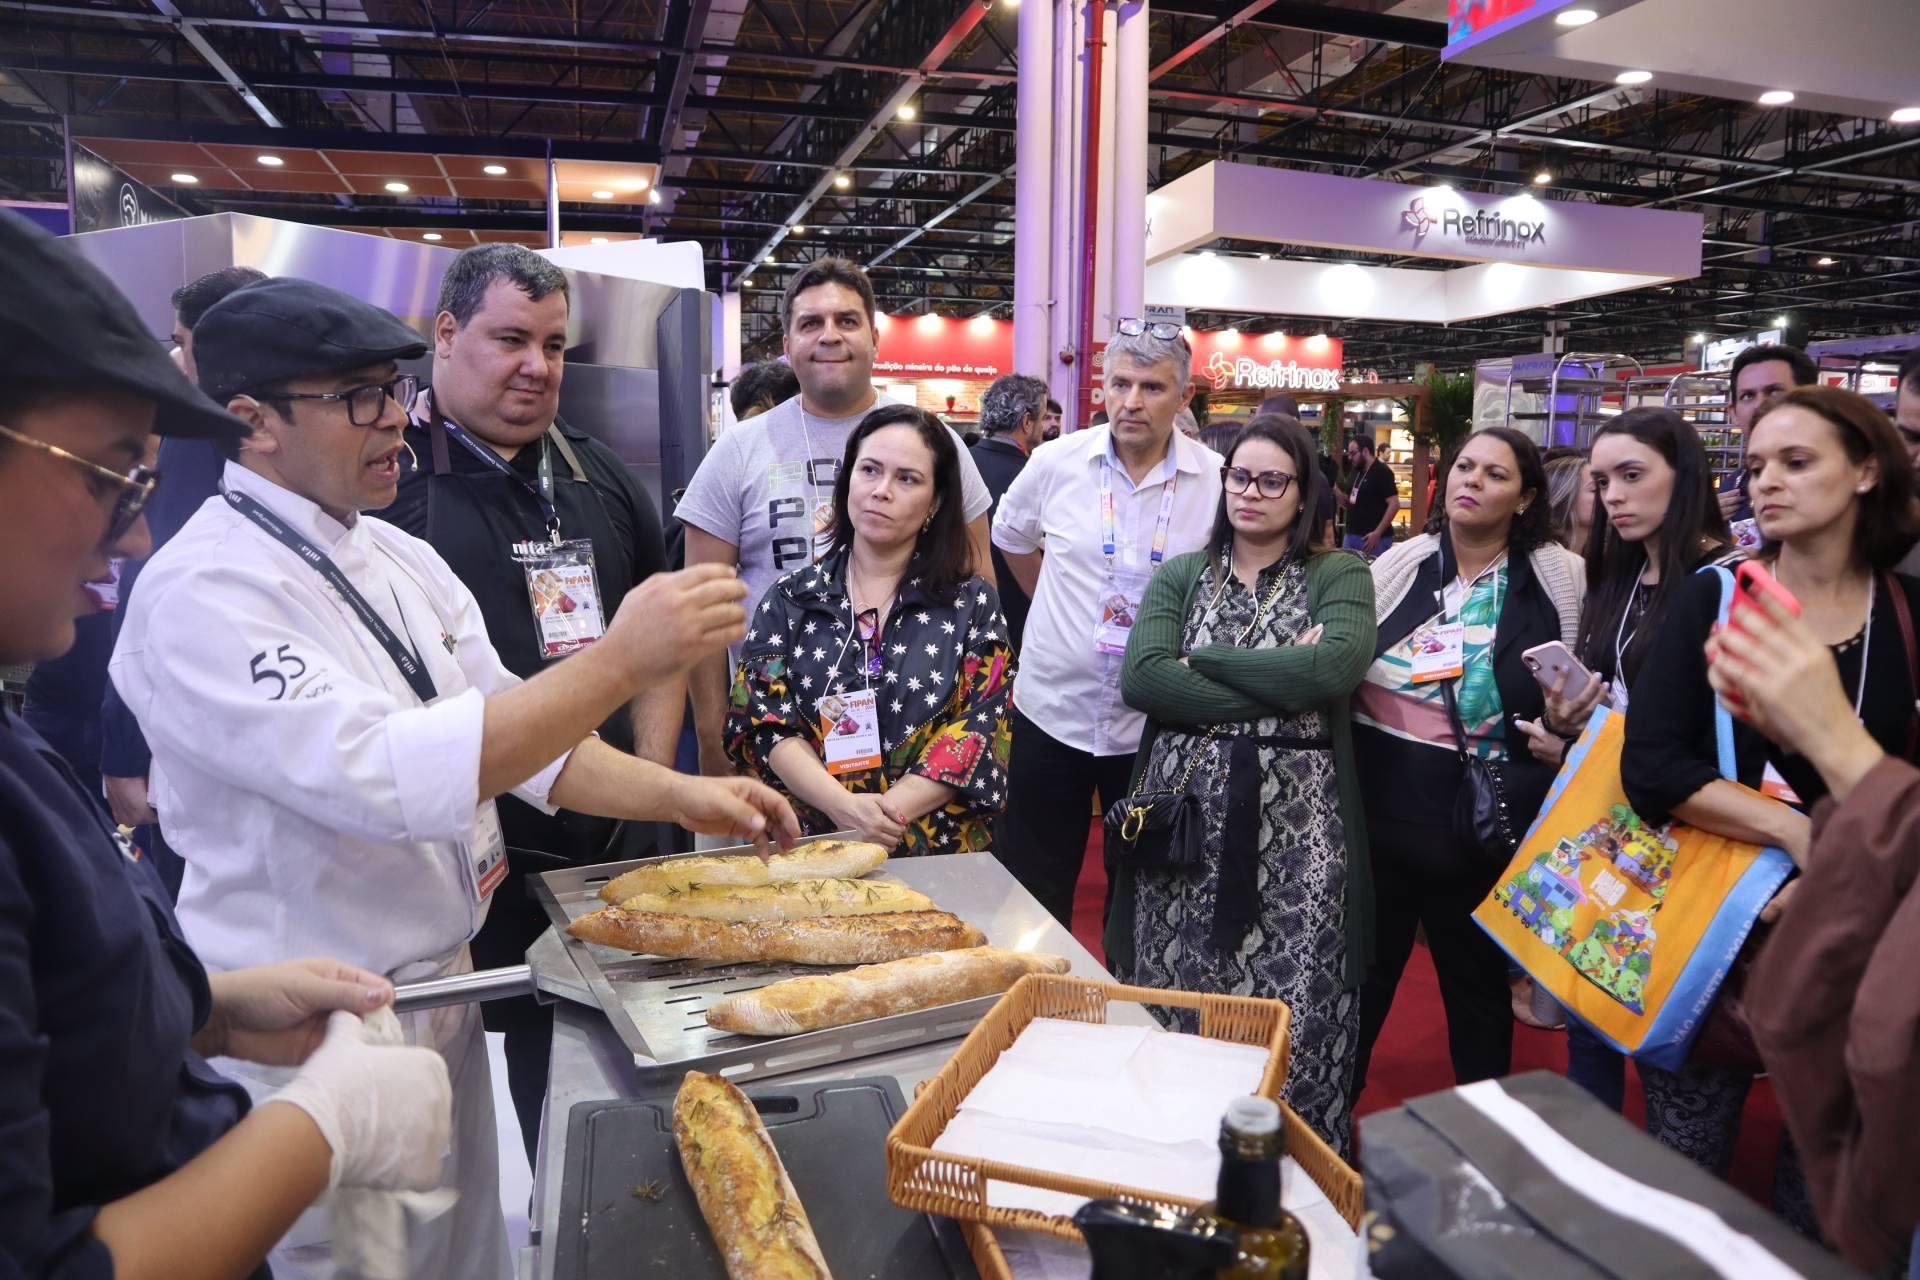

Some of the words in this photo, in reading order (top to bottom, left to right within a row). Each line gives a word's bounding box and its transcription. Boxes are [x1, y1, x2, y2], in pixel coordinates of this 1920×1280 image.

[1443, 208, 1546, 245] Refrinox
[905, 363, 932, 371] mineira
[946, 364, 961, 374] pão
[974, 366, 997, 375] queijo
[1235, 358, 1341, 390] Refrinox
[250, 644, 305, 701] 55
[849, 697, 874, 708] FIPAN
[839, 759, 870, 769] VISITANTE
[1692, 968, 1727, 1015] EXISTE
